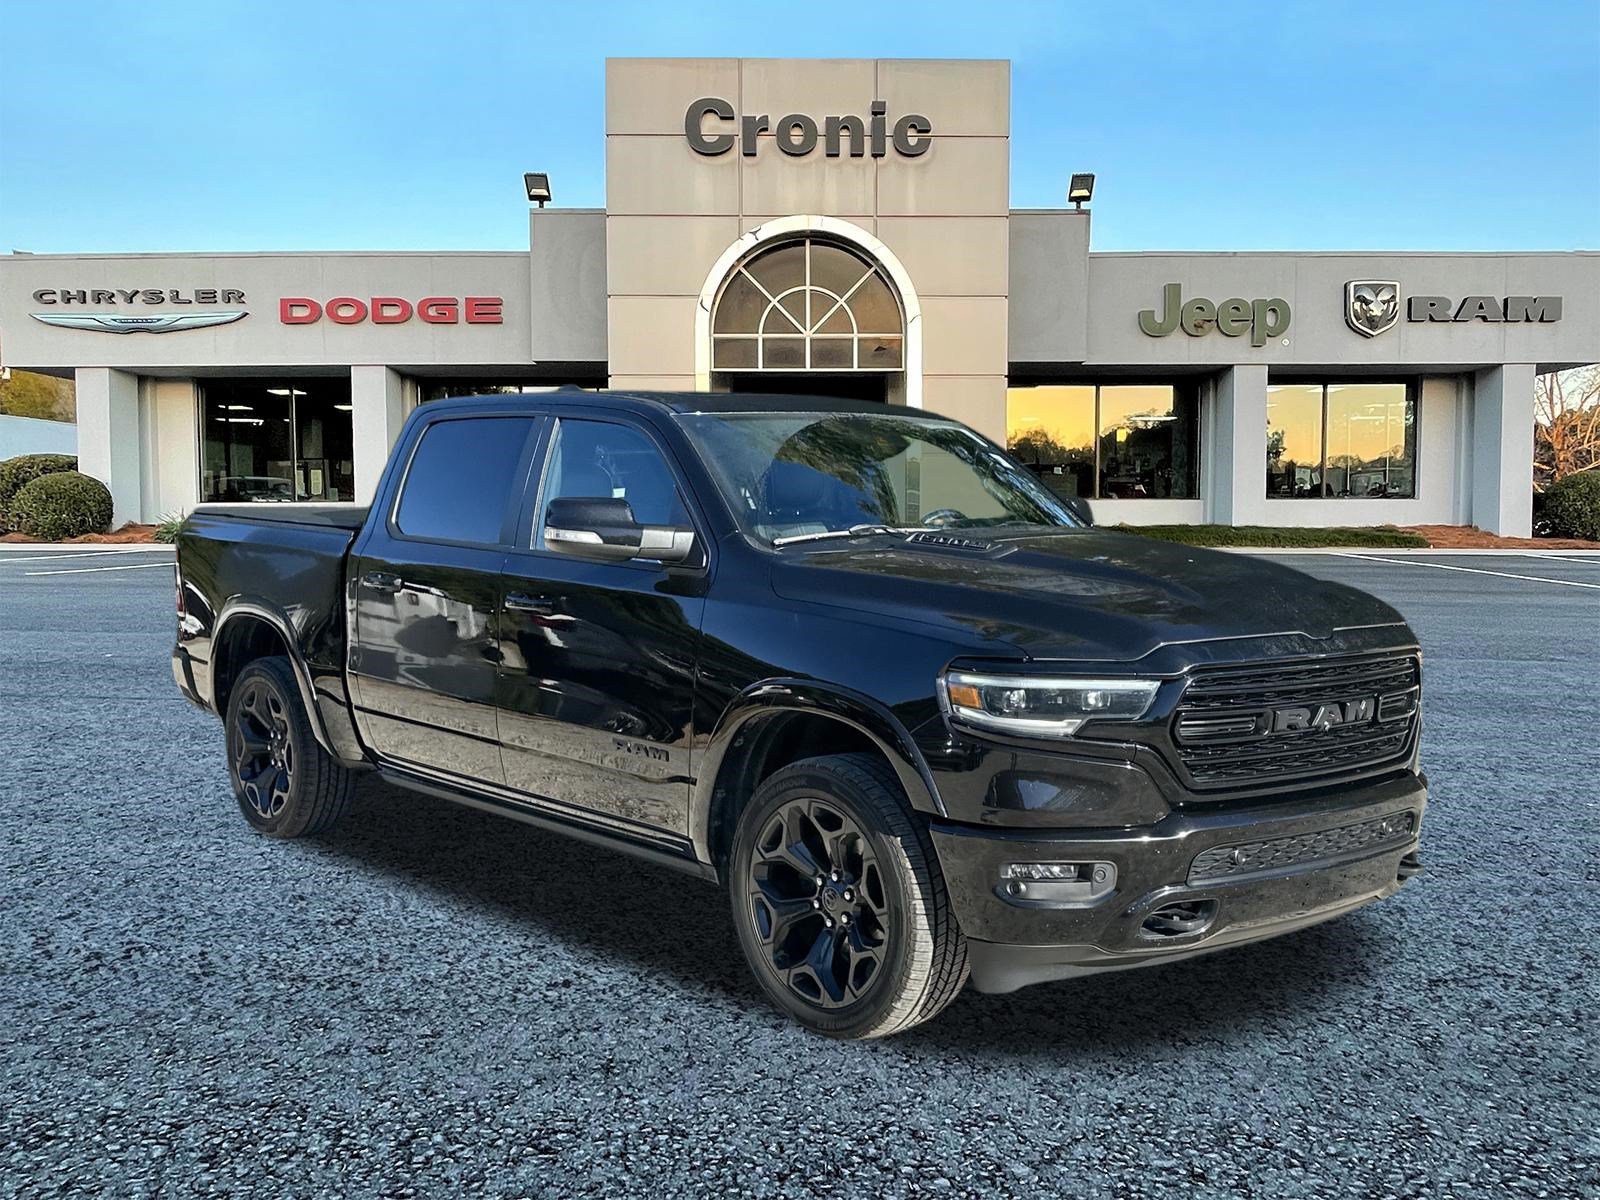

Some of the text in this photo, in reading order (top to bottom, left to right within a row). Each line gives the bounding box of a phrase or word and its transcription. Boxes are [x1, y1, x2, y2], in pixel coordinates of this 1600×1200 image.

[685, 97, 932, 157] Cronic
[32, 289, 246, 304] CHRYSLER
[280, 297, 503, 324] DODGE
[1407, 296, 1562, 322] RAM
[1138, 283, 1291, 347] Jeep
[1275, 699, 1375, 731] RAM
